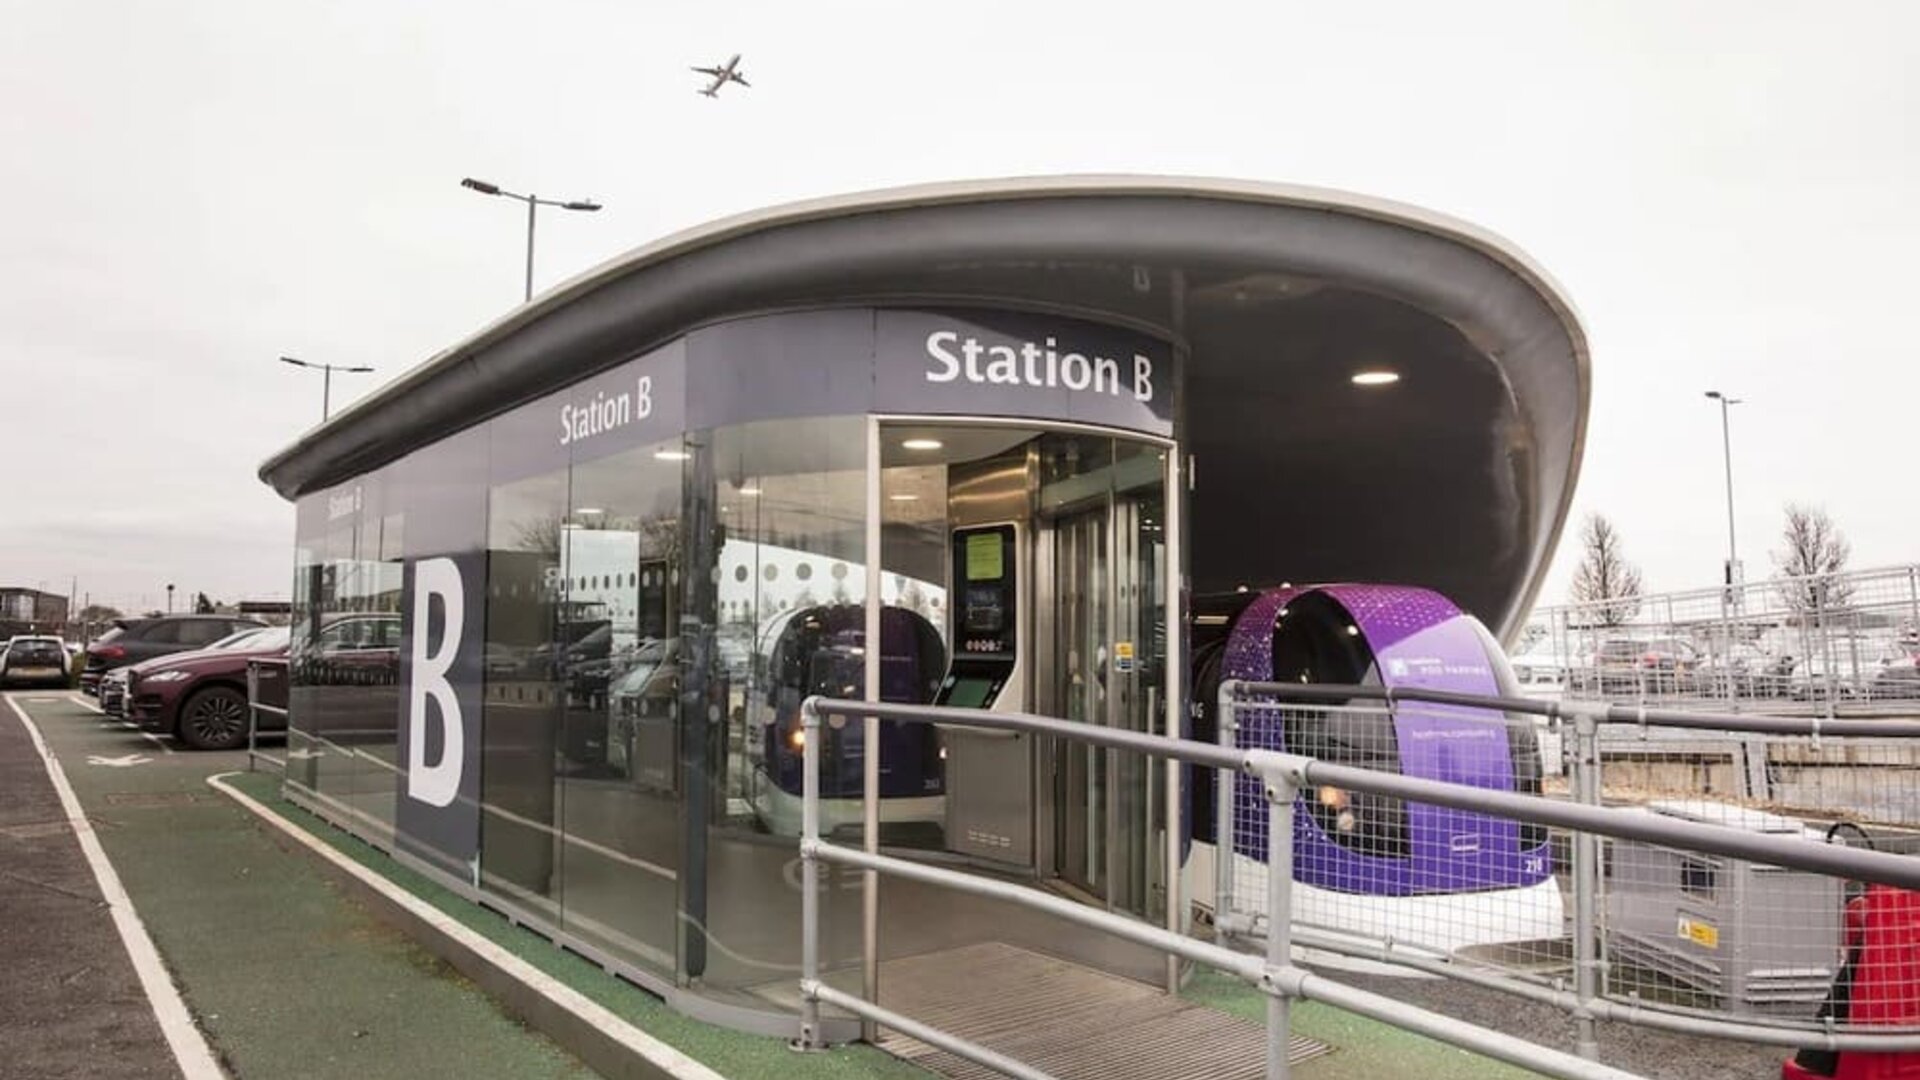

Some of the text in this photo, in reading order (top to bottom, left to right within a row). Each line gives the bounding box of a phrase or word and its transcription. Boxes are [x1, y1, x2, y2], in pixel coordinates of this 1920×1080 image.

[926, 331, 1154, 402] Station B
[560, 376, 652, 445] Station B
[408, 557, 464, 807] B
